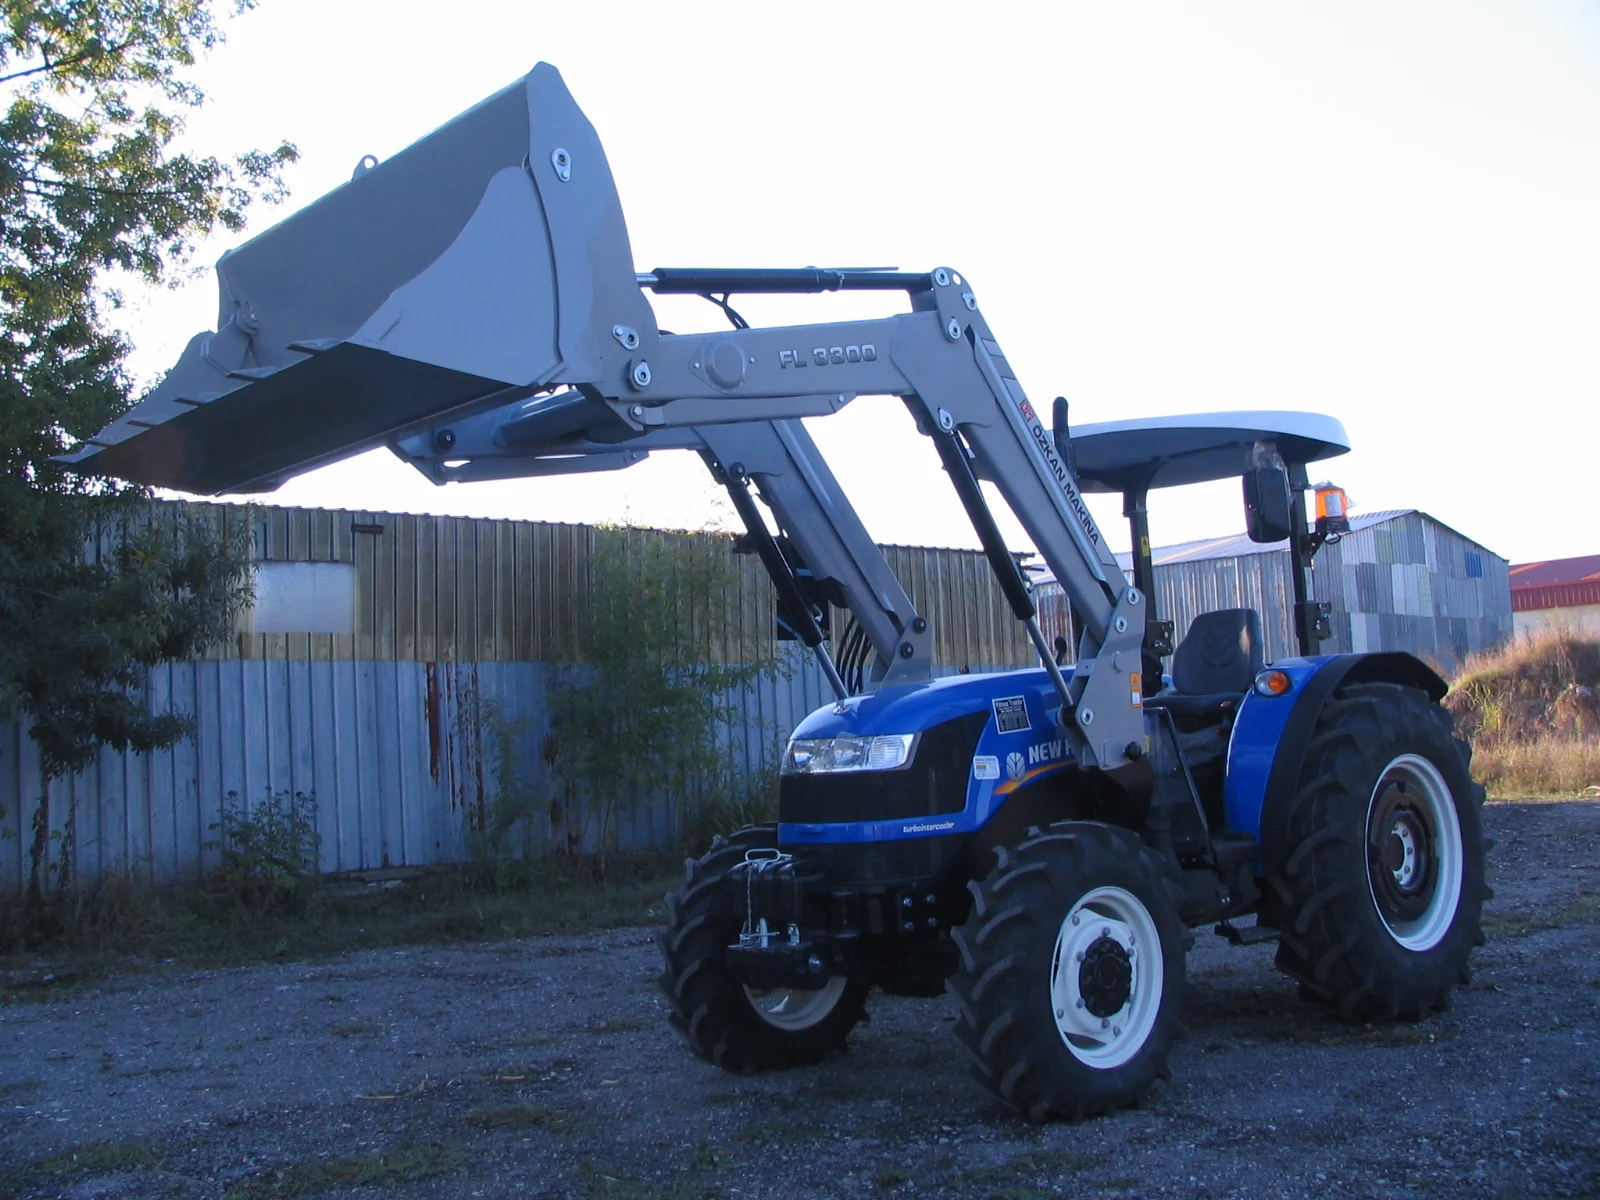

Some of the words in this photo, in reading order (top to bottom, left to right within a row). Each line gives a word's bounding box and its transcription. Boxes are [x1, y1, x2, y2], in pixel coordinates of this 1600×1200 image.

[779, 350, 808, 370] FL
[813, 344, 877, 367] 3300
[1032, 424, 1066, 482] ÖZKAN
[1064, 484, 1099, 546] MAKİNA
[1029, 739, 1062, 765] NEW
